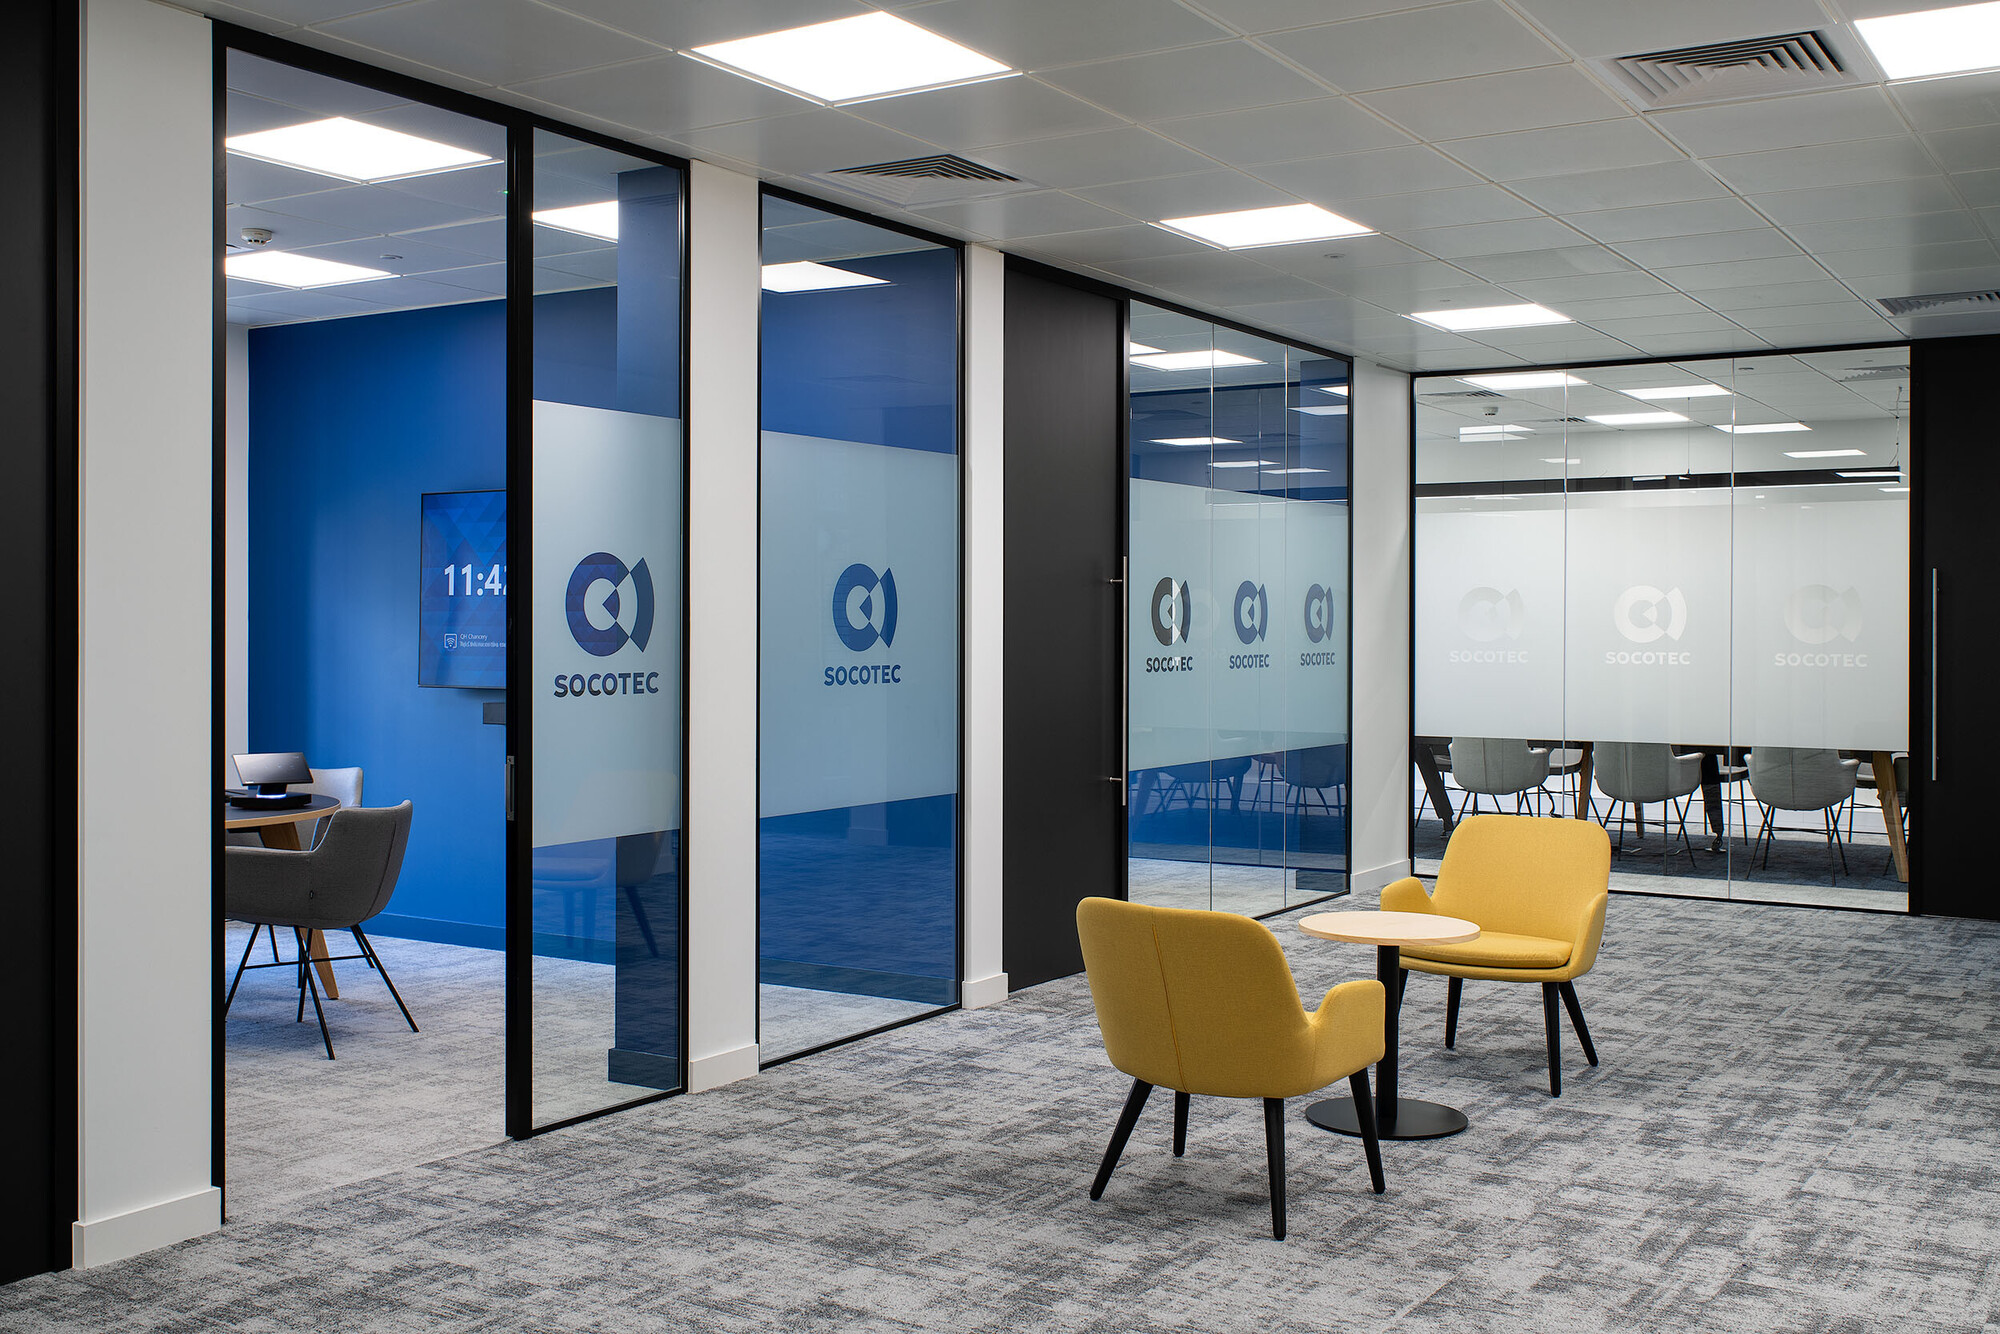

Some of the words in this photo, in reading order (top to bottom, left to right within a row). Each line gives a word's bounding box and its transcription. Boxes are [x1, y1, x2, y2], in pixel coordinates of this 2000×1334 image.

[1146, 656, 1193, 673] SOCOTEC
[1229, 653, 1270, 670] SOCOTEC
[1300, 652, 1335, 666] SOCOTEC
[1449, 649, 1529, 664] SOCOTEC
[1605, 651, 1691, 666] SOCOTEC
[1774, 652, 1868, 668] SOCOTEC
[824, 664, 902, 687] SOCOTEC
[554, 671, 659, 698] SOCOTEC
